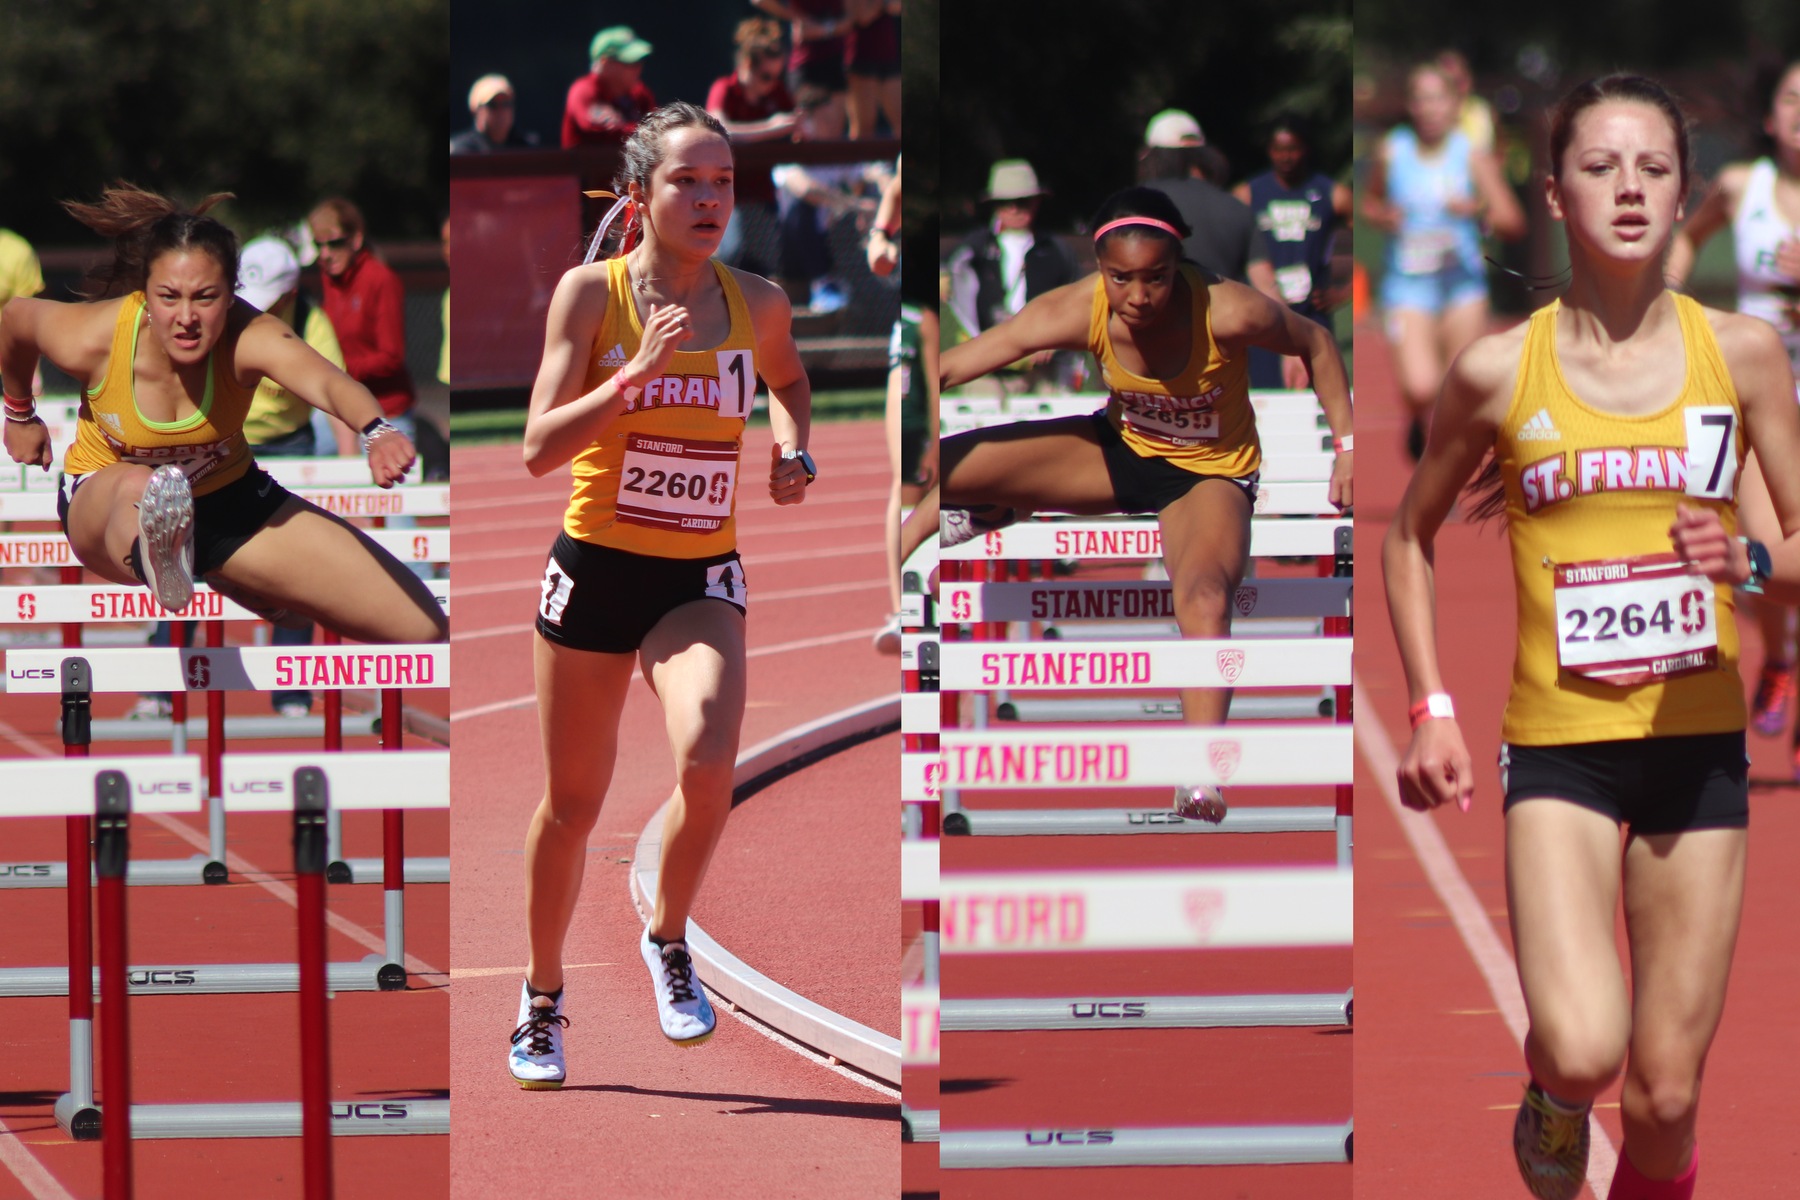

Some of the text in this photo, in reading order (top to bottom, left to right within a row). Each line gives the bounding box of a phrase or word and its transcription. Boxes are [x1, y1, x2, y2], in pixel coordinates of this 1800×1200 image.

[728, 354, 745, 413] 1
[1518, 427, 1561, 441] adidas
[636, 439, 683, 454] STANFORD
[1700, 414, 1734, 492] 7
[623, 467, 707, 501] 2260
[1565, 564, 1629, 584] STANFORD
[91, 592, 223, 619] STANRD
[1565, 600, 1675, 643] 2264
[10, 669, 55, 679] UCS
[275, 654, 434, 687] STANFORD
[982, 652, 1151, 686] STANFORD
[1652, 652, 1706, 675] CARDINAL
[138, 782, 193, 795] UCS
[230, 780, 285, 794] UCS
[1128, 812, 1186, 825] UCS
[129, 969, 197, 986] UCS
[1072, 1002, 1147, 1019] UCS
[330, 1103, 408, 1120] UCS
[1025, 1129, 1115, 1146] UCS
